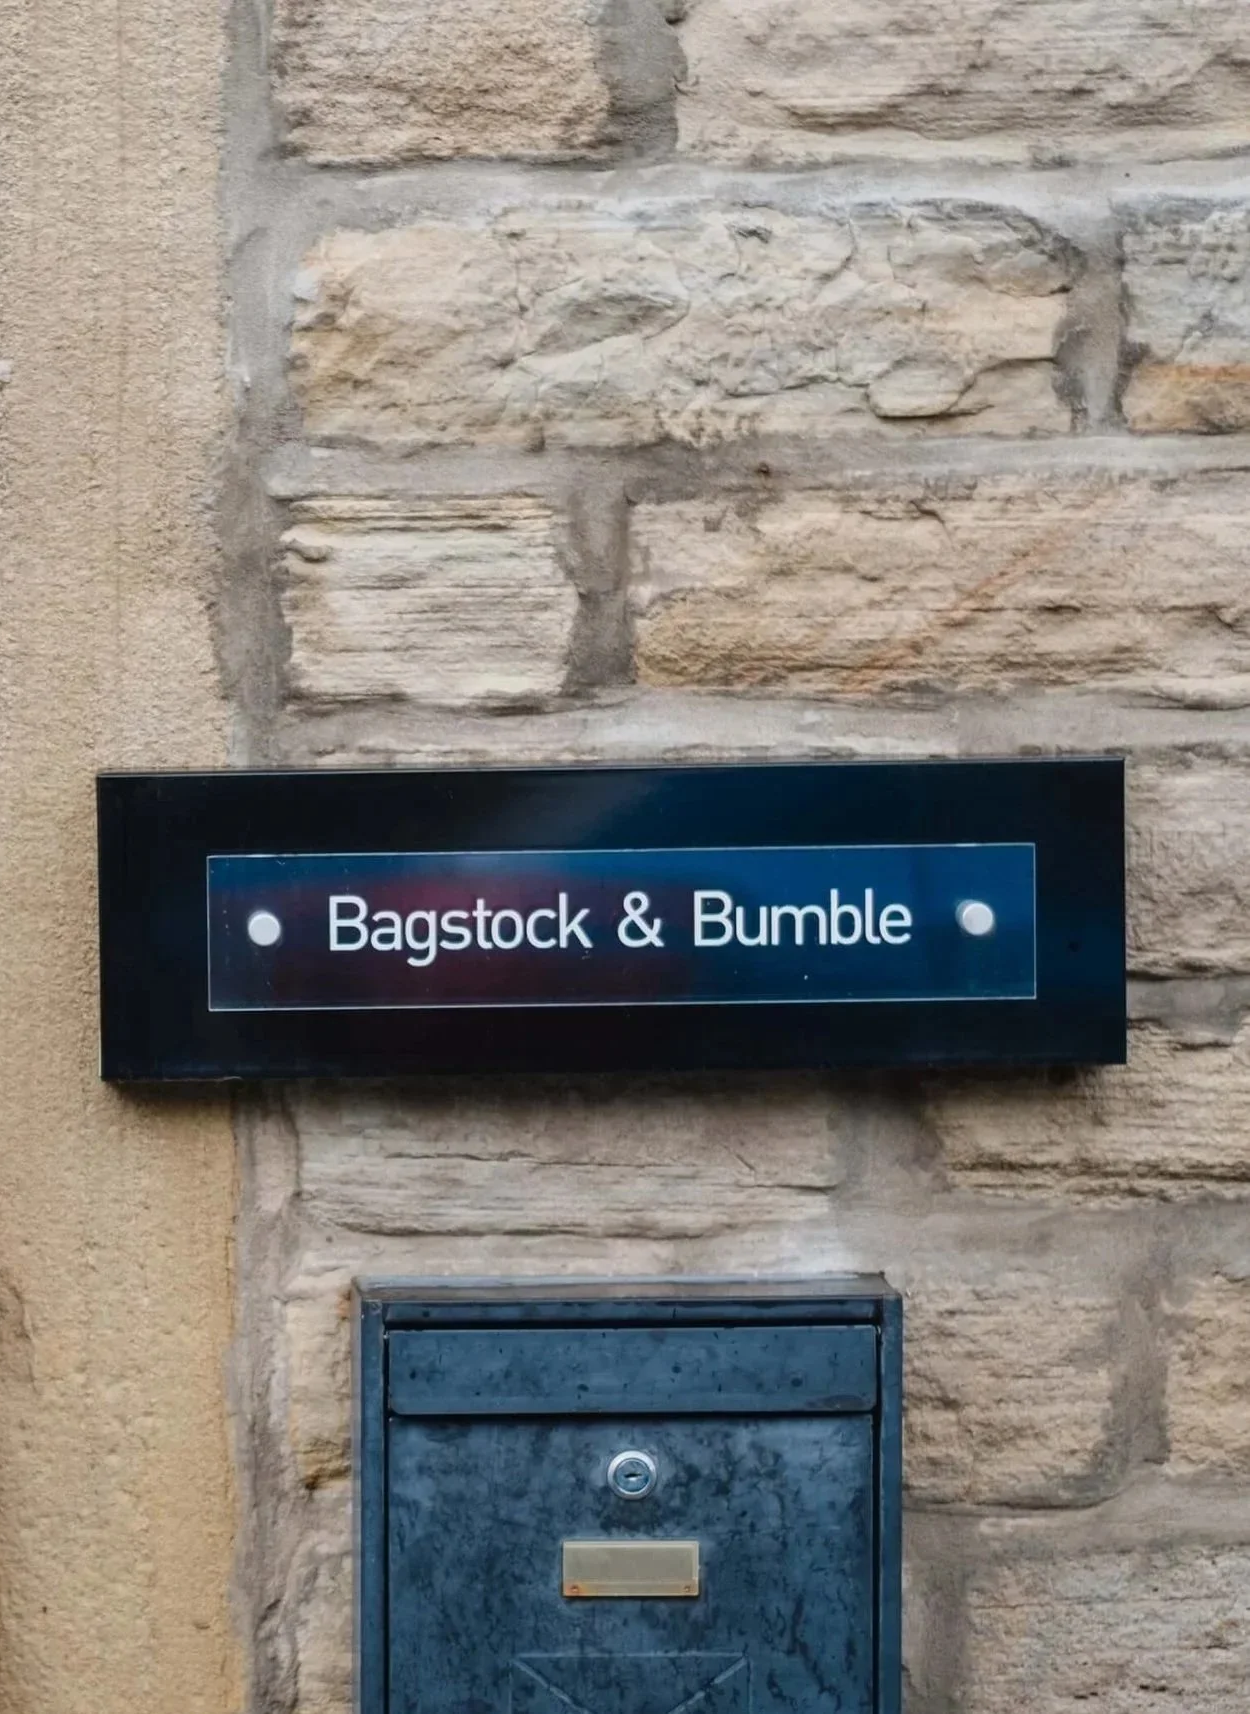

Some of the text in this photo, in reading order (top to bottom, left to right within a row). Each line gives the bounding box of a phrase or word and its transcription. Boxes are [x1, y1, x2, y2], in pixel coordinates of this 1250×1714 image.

[328, 887, 913, 967] Bagstock & Bumble
